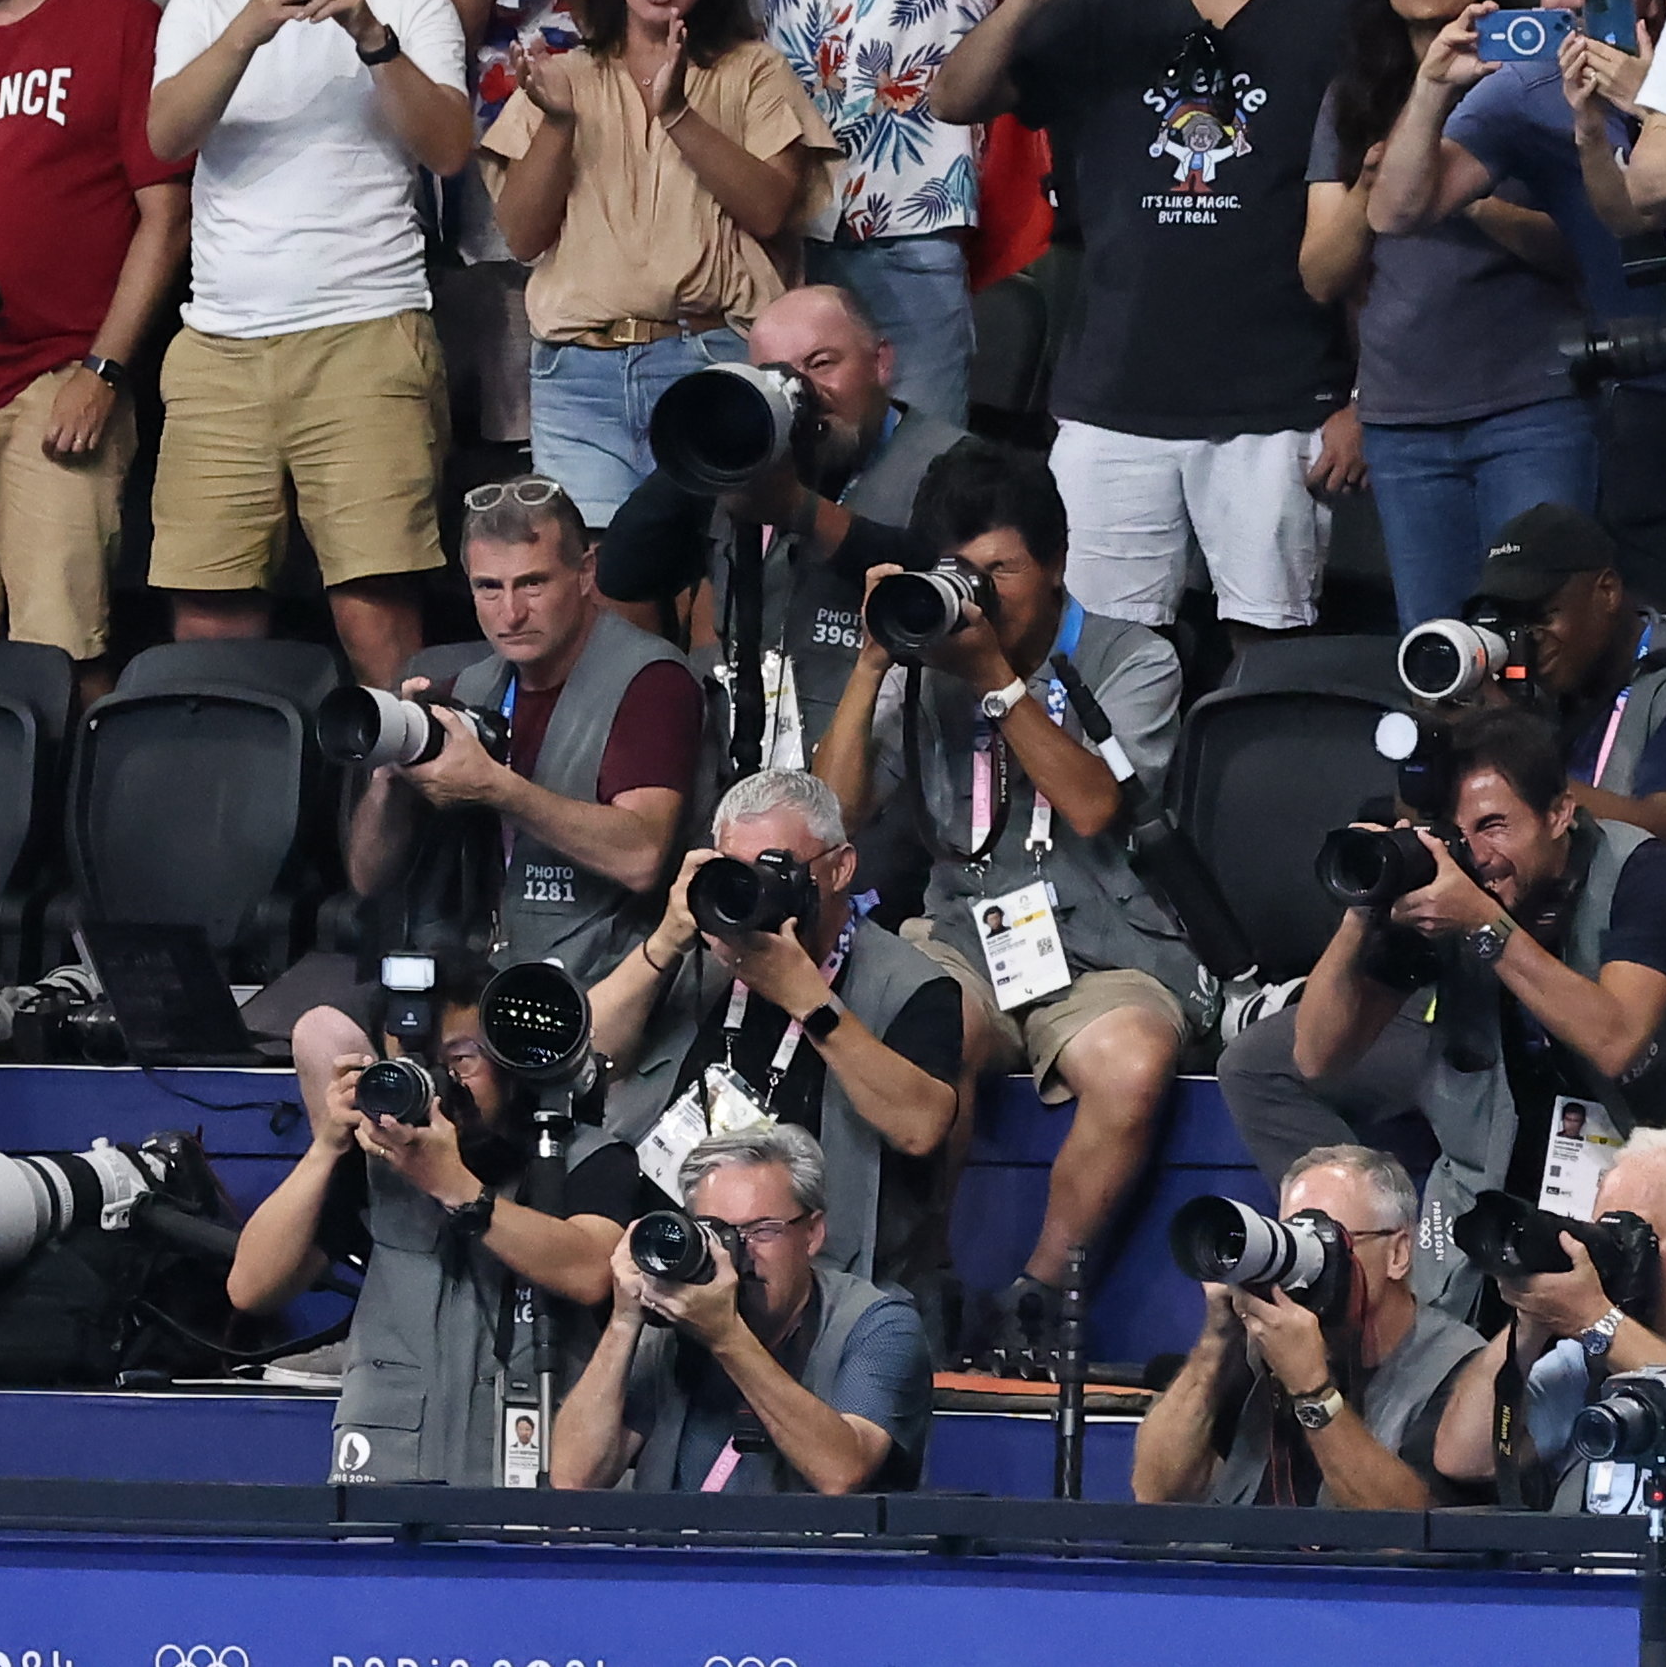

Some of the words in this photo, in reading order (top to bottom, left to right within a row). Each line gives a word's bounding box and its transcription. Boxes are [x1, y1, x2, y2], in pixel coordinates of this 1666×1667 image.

[1158, 210, 1182, 223] BUT
[817, 607, 863, 627] PHOT
[525, 863, 575, 880] PHOTO
[522, 879, 576, 903] 1281
[1434, 1234, 1444, 1261] 2024
[1501, 1405, 1511, 1440] Nikon
